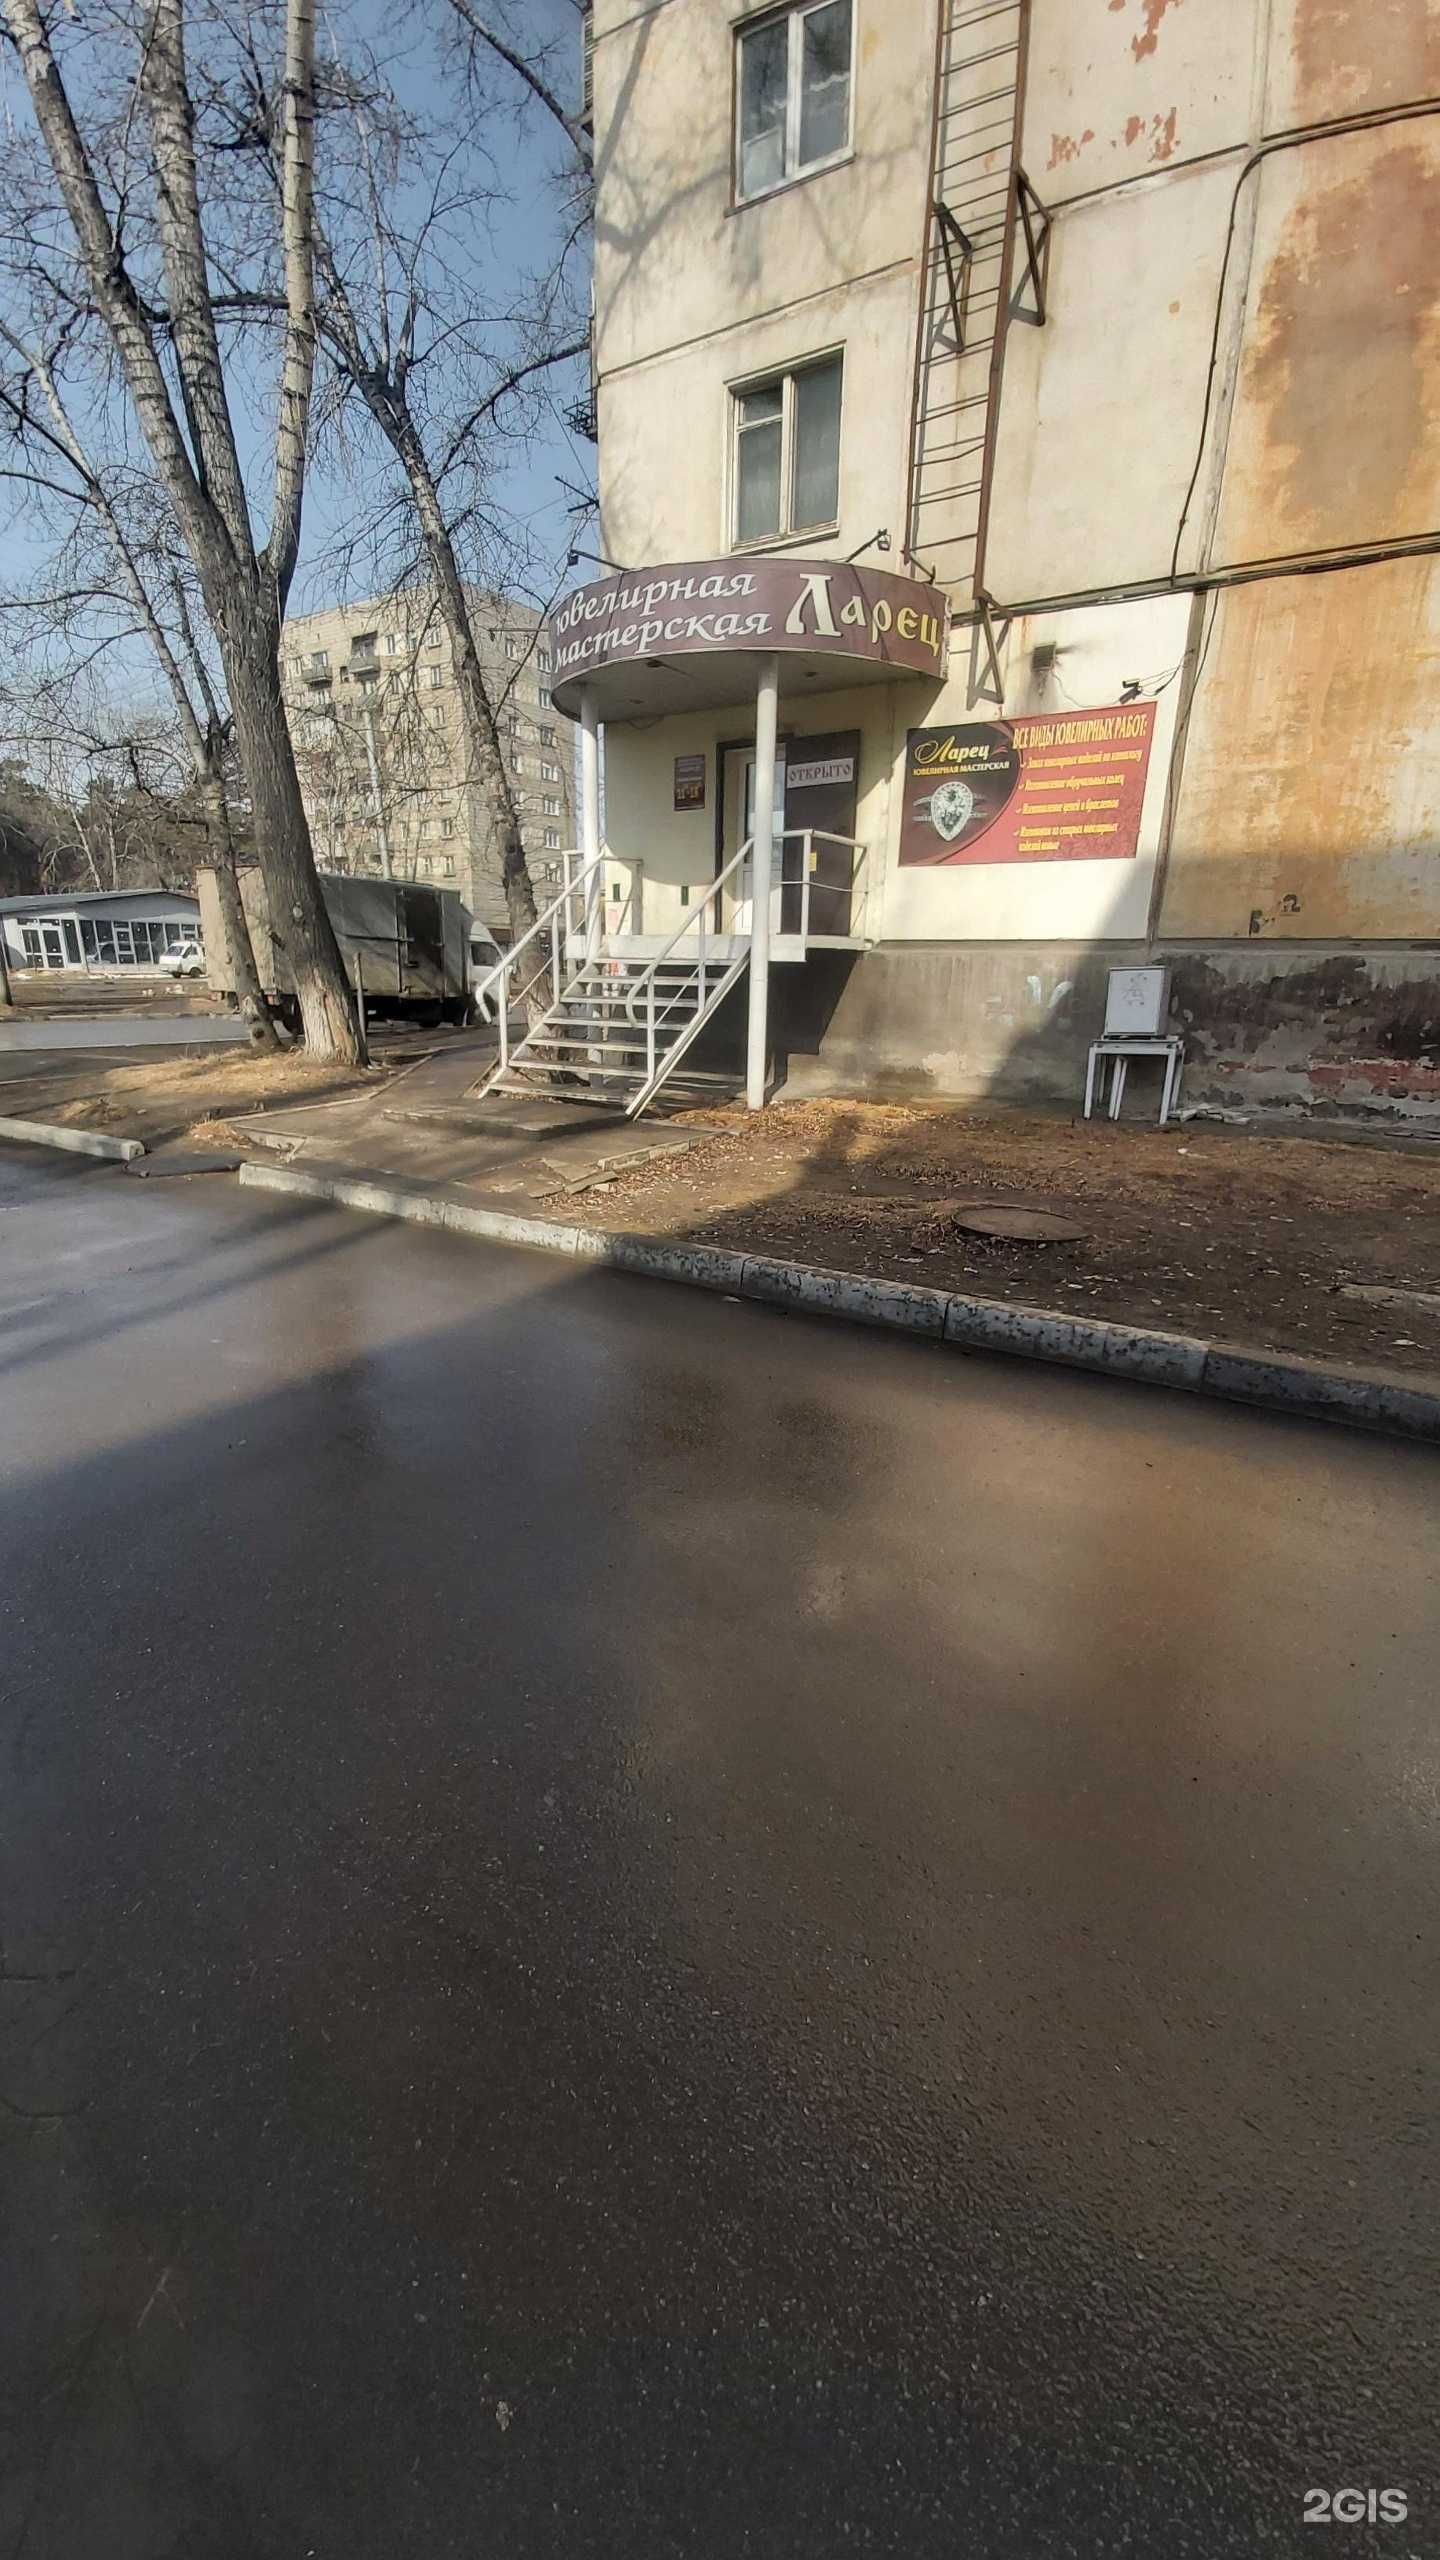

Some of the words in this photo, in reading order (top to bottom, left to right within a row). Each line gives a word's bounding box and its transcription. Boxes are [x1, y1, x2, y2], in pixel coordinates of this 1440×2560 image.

[786, 573, 939, 657] Ларец
[555, 613, 773, 673] мастерская
[1013, 727, 1028, 749] ВСЕ
[1029, 724, 1055, 750] ВИДЫ
[1055, 717, 1113, 745] ЮВЕЛИРНЫХ
[1114, 713, 1148, 739] РАБОТ:
[914, 736, 990, 764] Ларец
[789, 764, 851, 782] ОТКРЫТО
[959, 761, 1010, 773] МАСТЕРСКАЯ
